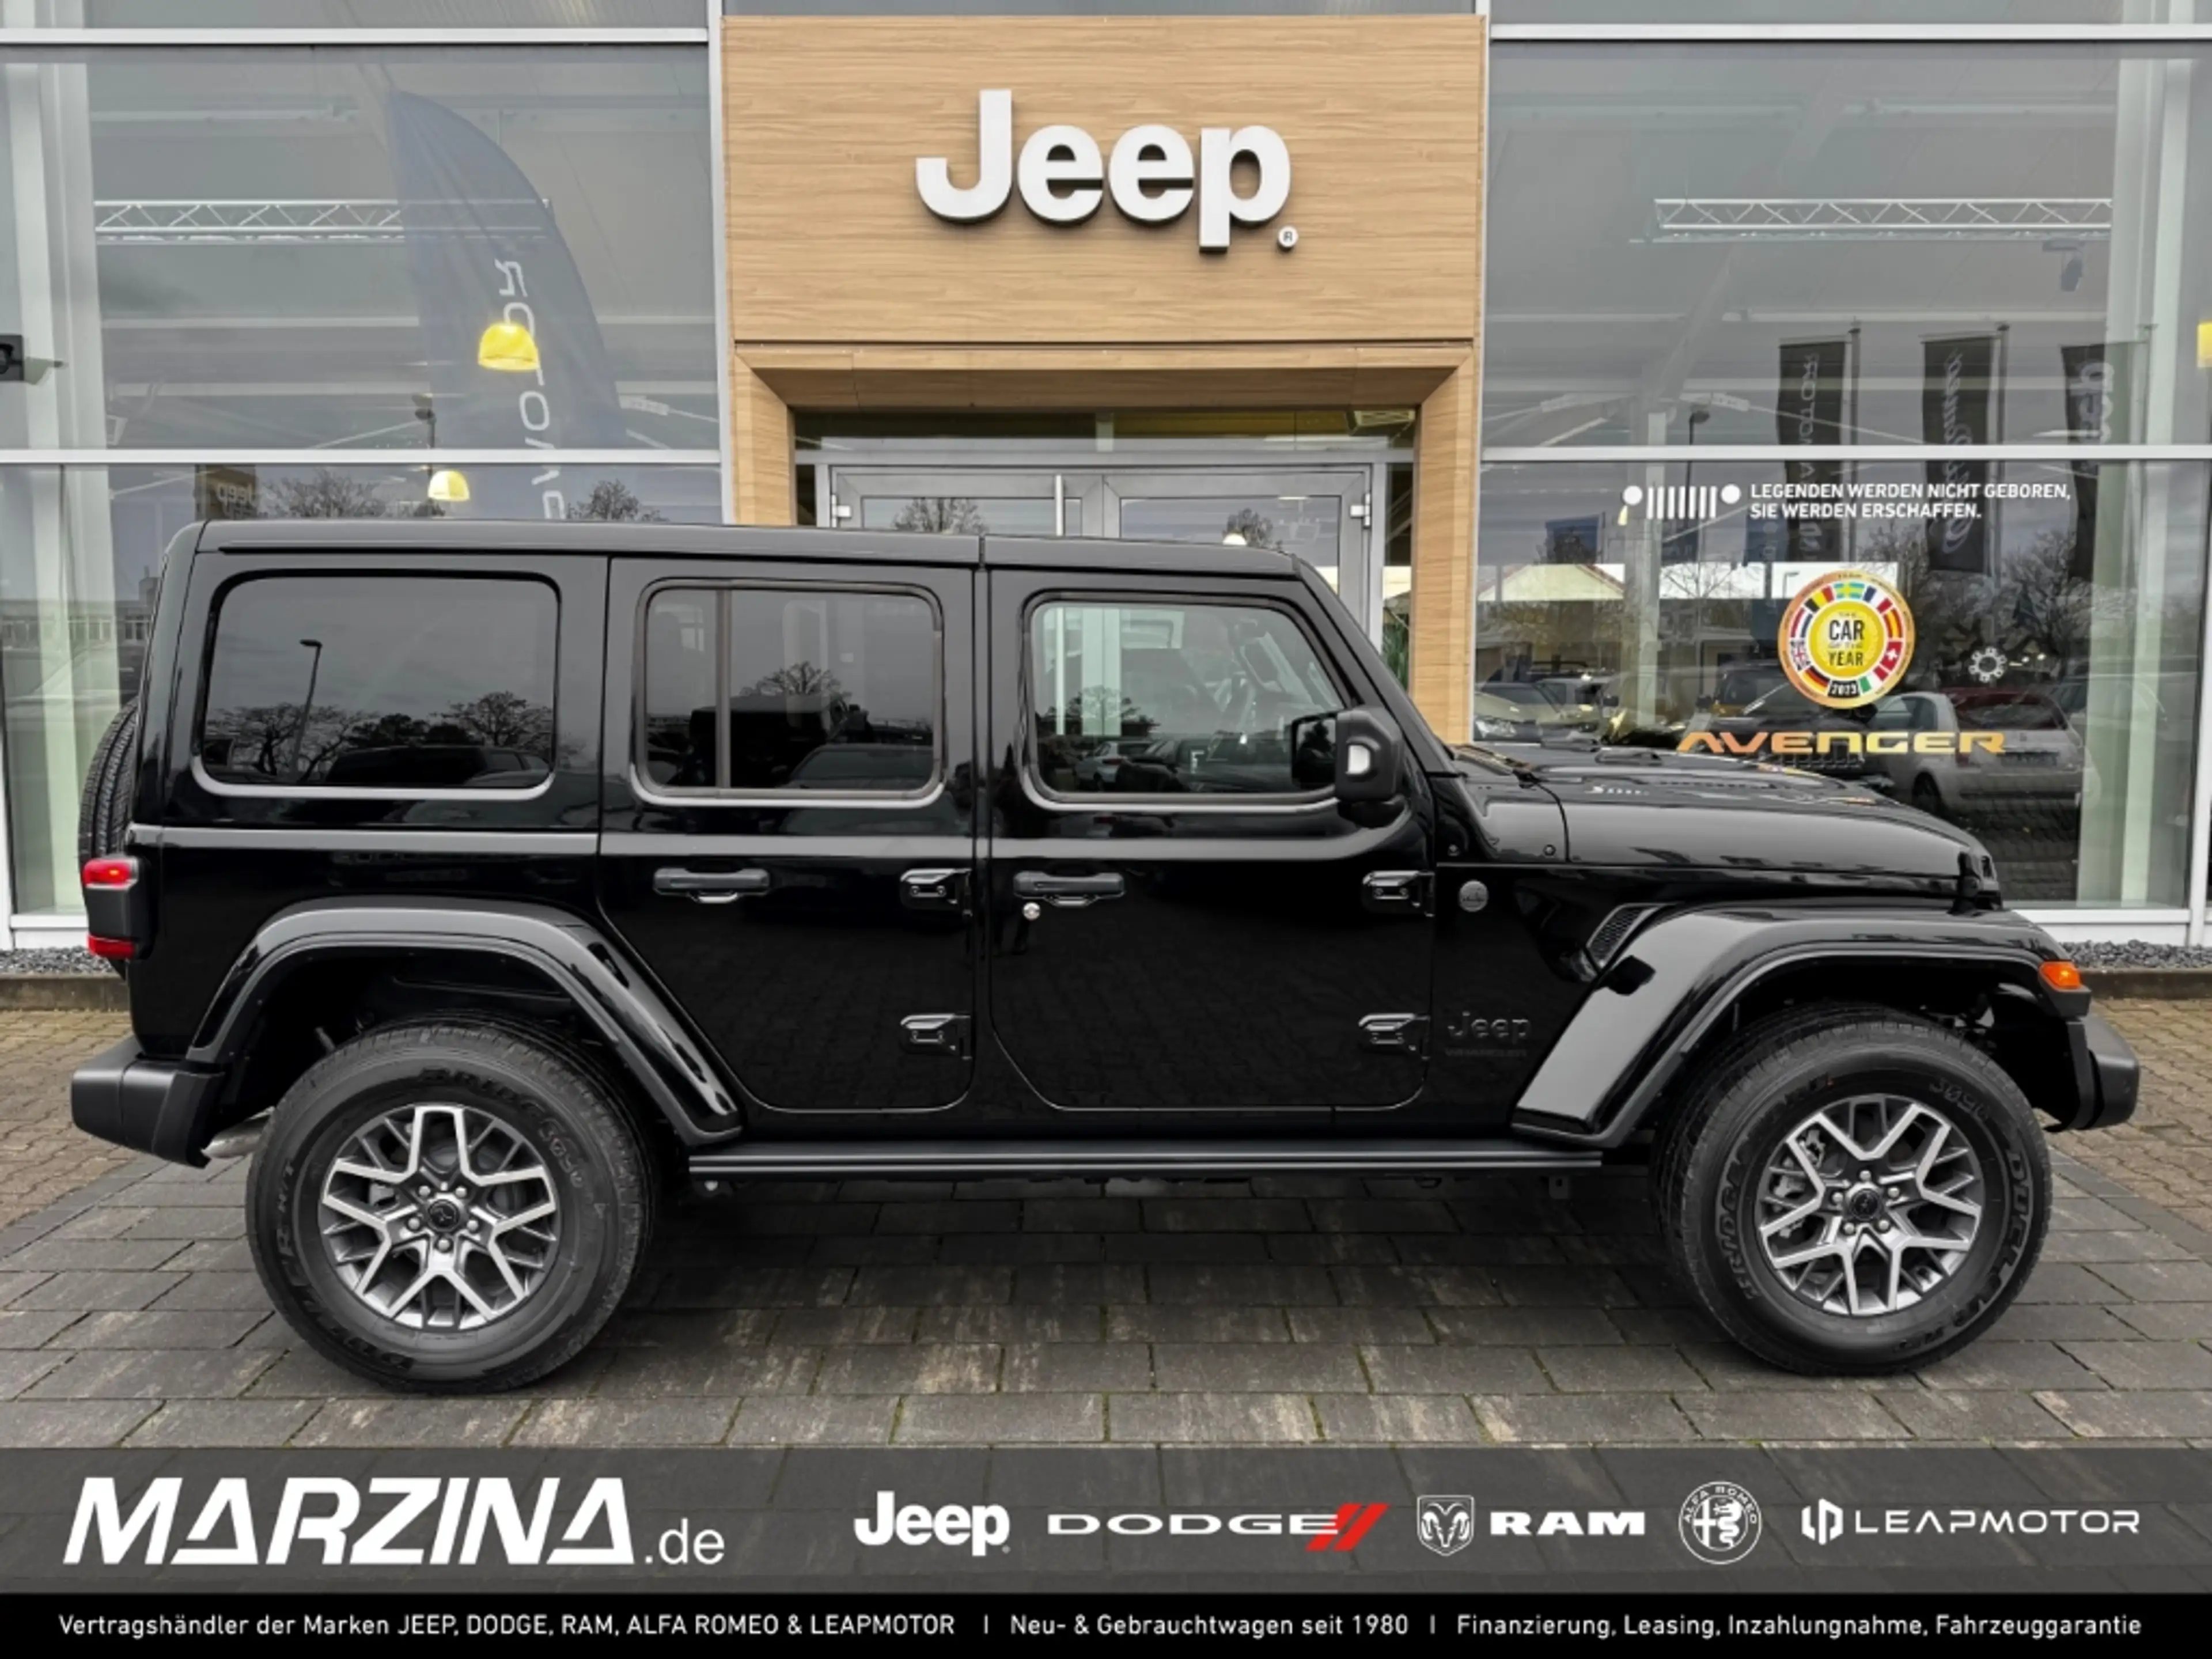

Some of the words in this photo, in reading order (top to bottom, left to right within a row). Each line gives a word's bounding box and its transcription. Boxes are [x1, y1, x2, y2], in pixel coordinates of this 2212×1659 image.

[916, 89, 1292, 248] Jeep
[1751, 483, 1843, 499] LEGENDEN
[1847, 483, 1926, 499] WERDEN
[1928, 483, 1980, 499] NICHT
[1984, 483, 2071, 501] GEBOREN,
[1749, 502, 1778, 518] SIE
[1781, 502, 1857, 518] WERDEN
[1861, 502, 1982, 519] ERSCHAFFEN.
[1828, 619, 1865, 641] CAR
[1828, 652, 1865, 666] YEAR
[1677, 732, 2006, 753] AVENGER
[1447, 1011, 1532, 1044] Jeep
